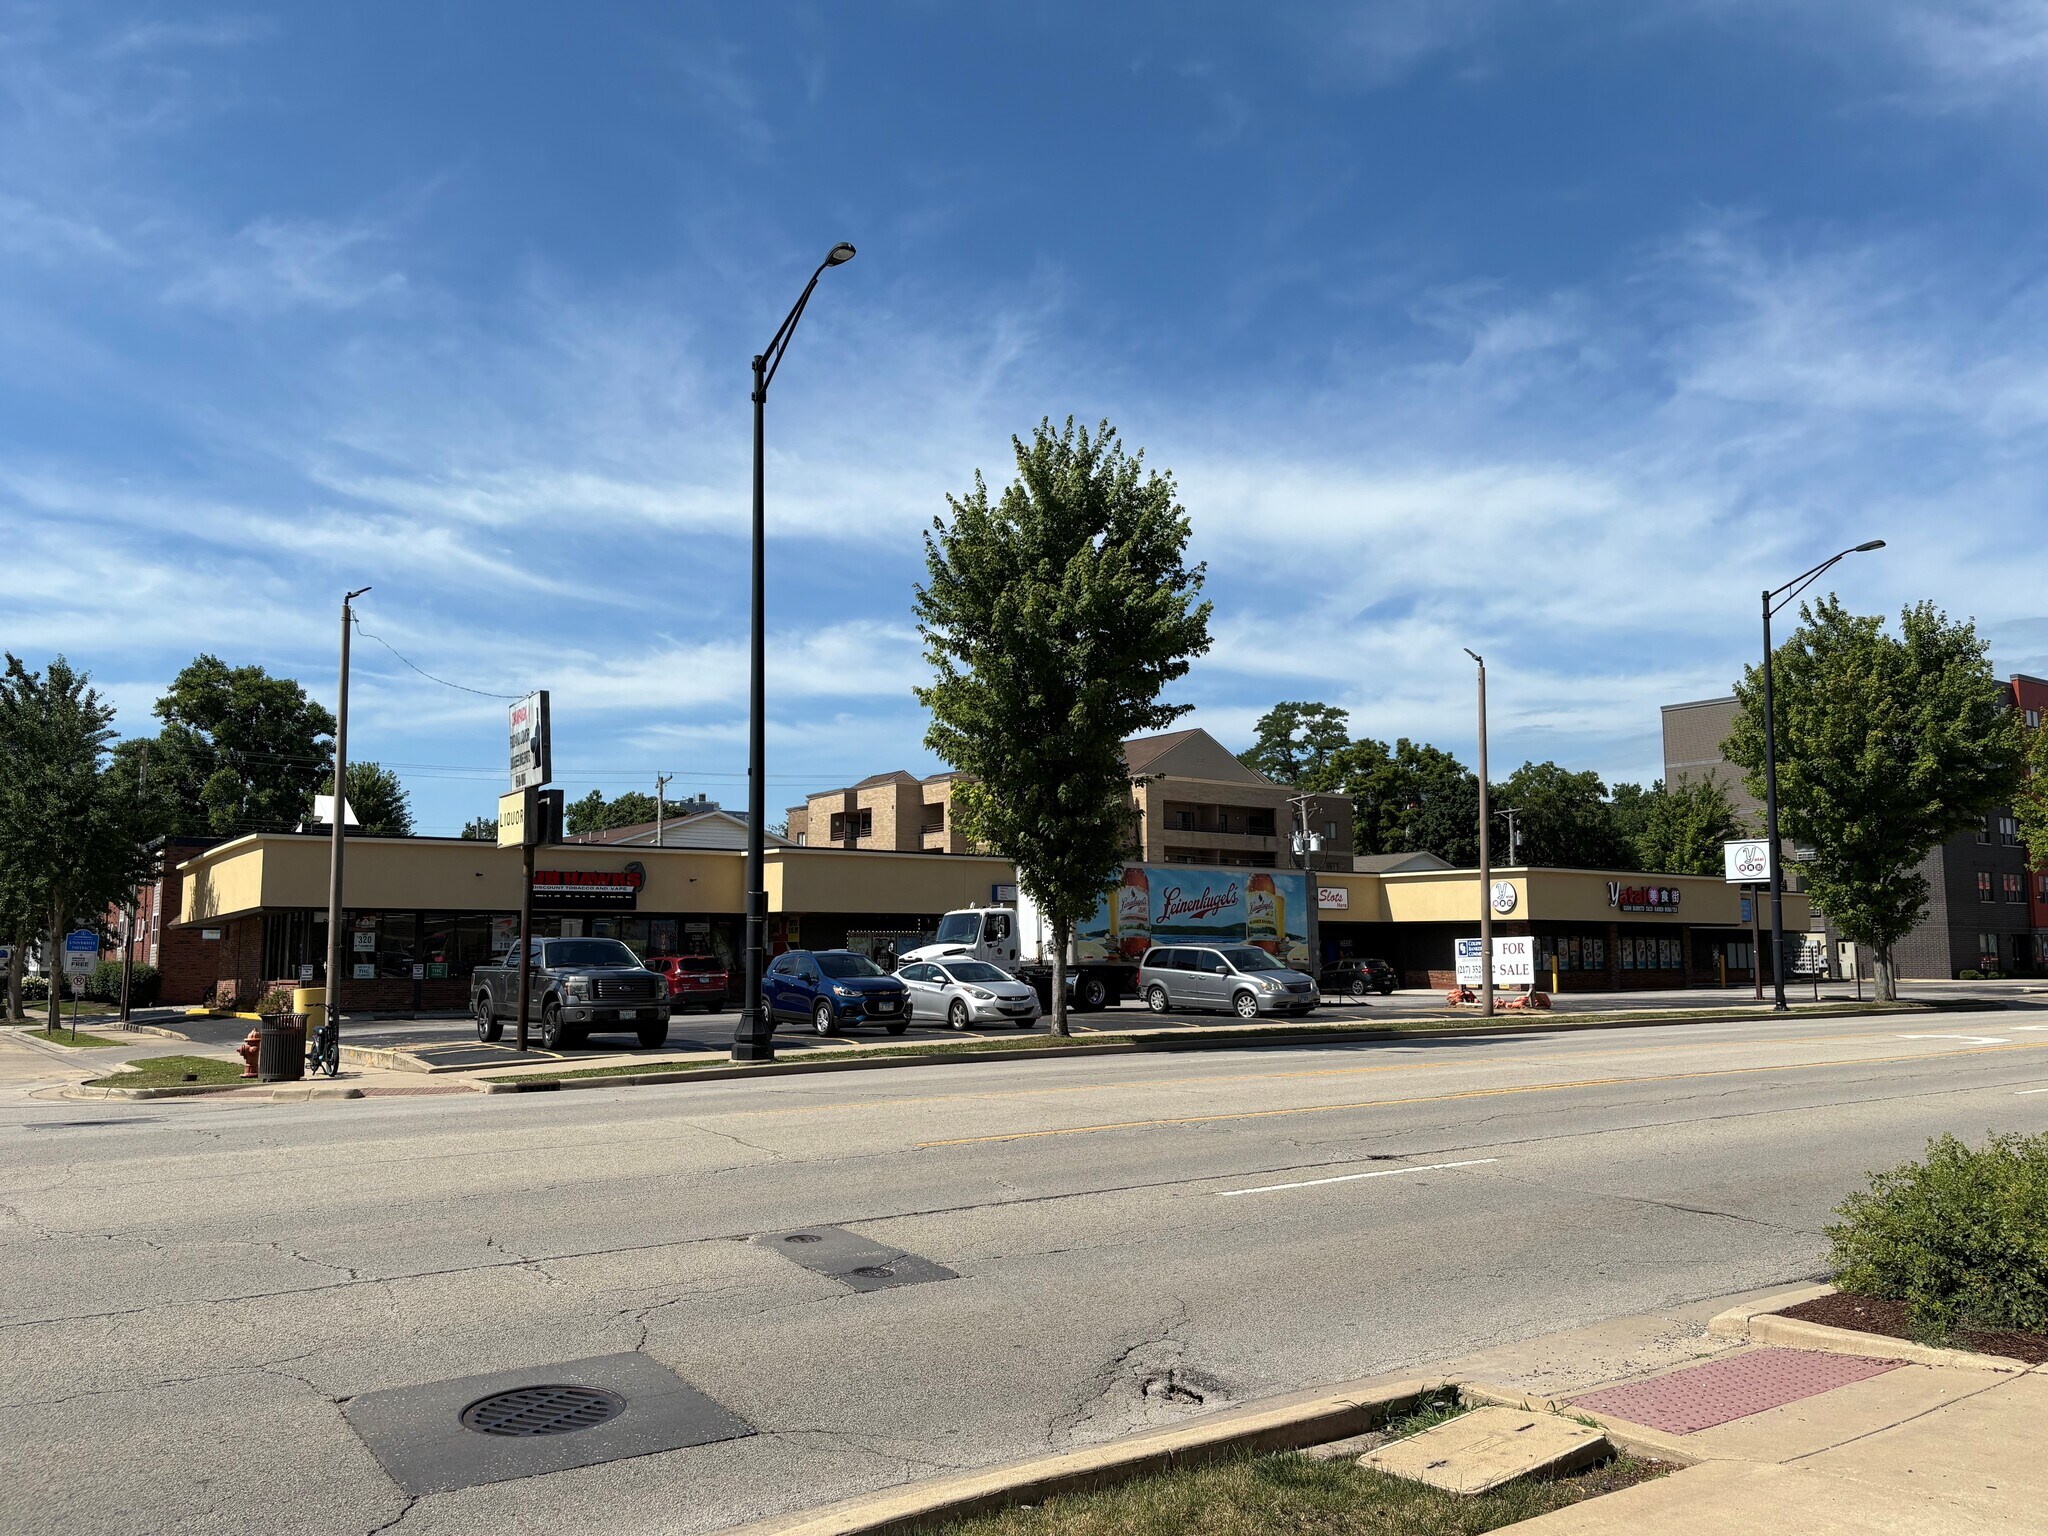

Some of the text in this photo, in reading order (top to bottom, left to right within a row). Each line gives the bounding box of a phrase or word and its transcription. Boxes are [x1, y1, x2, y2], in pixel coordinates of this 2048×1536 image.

[500, 808, 524, 828] LIQUOR
[563, 872, 641, 886] HAWKS
[1319, 889, 1344, 902] Slots
[1156, 882, 1239, 924] Leinenkugel's
[1502, 943, 1525, 954] FOR
[1457, 965, 1471, 975] (217)
[1500, 963, 1529, 976] SALE
